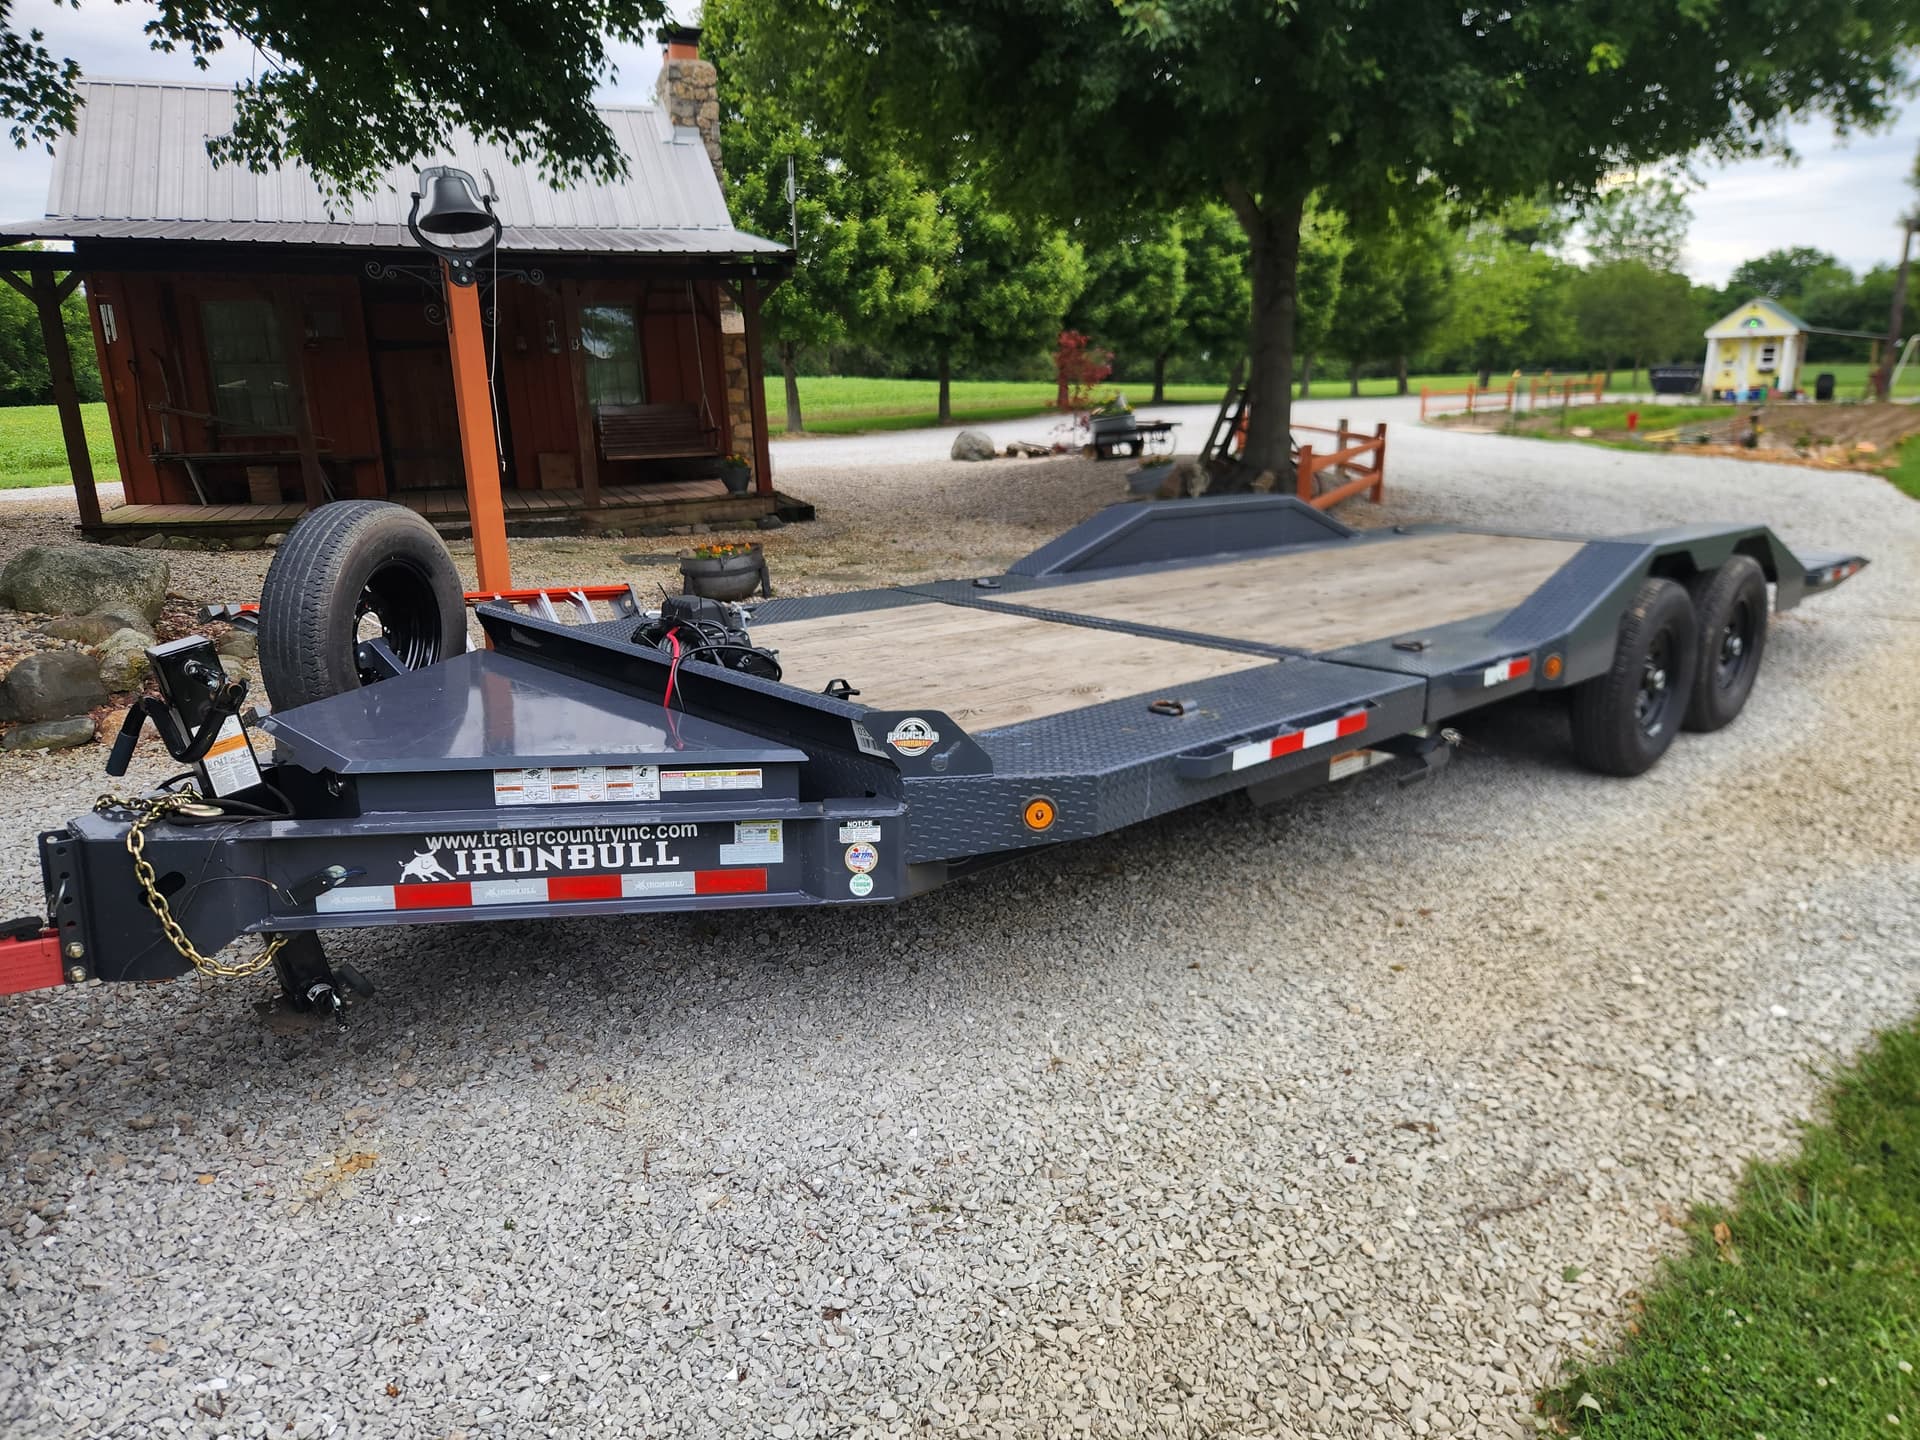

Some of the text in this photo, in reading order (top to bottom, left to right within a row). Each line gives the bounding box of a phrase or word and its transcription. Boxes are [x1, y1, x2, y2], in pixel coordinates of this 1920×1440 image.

[425, 823, 698, 850] www.trailercountryinc.com
[847, 820, 873, 828] NOTICE
[454, 841, 680, 876] IRONBULL
